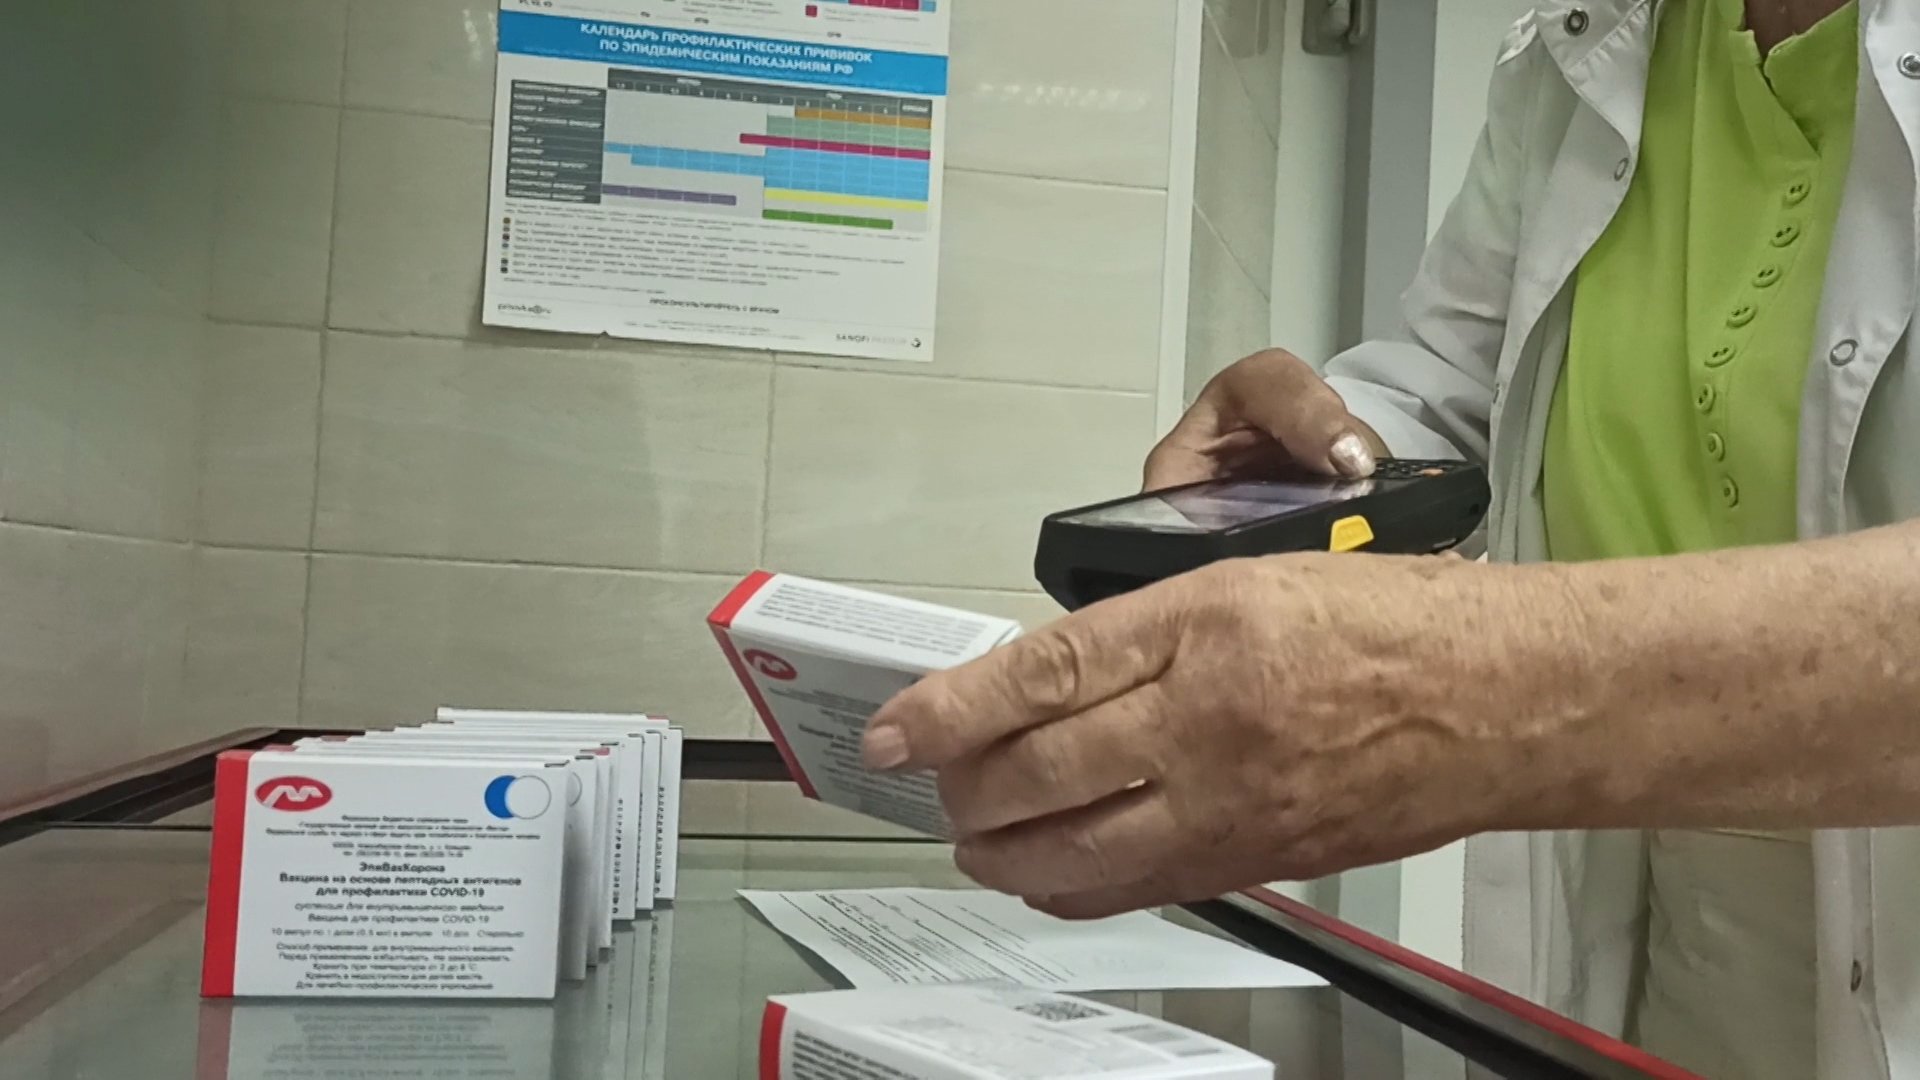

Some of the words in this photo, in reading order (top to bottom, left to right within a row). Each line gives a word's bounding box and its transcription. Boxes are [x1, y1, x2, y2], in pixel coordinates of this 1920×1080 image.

[580, 22, 659, 41] КАЛЕНДАРЬ
[661, 31, 801, 56] ПРОФИЛАКТИЧЕСКИХ
[803, 46, 873, 63] ПРИВИВОК
[599, 39, 619, 51] ПО
[622, 41, 741, 63] ЭПИДЕМИЧЕСКИМ
[743, 54, 828, 73] ПОКАЗАНИЯМ
[830, 63, 854, 75] РФ
[359, 861, 446, 874] ЭпиВакКорона
[279, 871, 330, 884] Вакцина
[332, 875, 347, 884] на
[349, 875, 392, 884] основе
[394, 876, 459, 886] пептидных
[462, 877, 522, 886] антигенов
[315, 886, 339, 897] для
[341, 887, 428, 898] профилактики
[430, 886, 485, 898] COVID-19
[346, 901, 364, 911] для
[308, 913, 349, 923] Вакцина
[350, 914, 370, 924] для
[371, 914, 440, 924] профилактики
[442, 914, 490, 924] COVID-19
